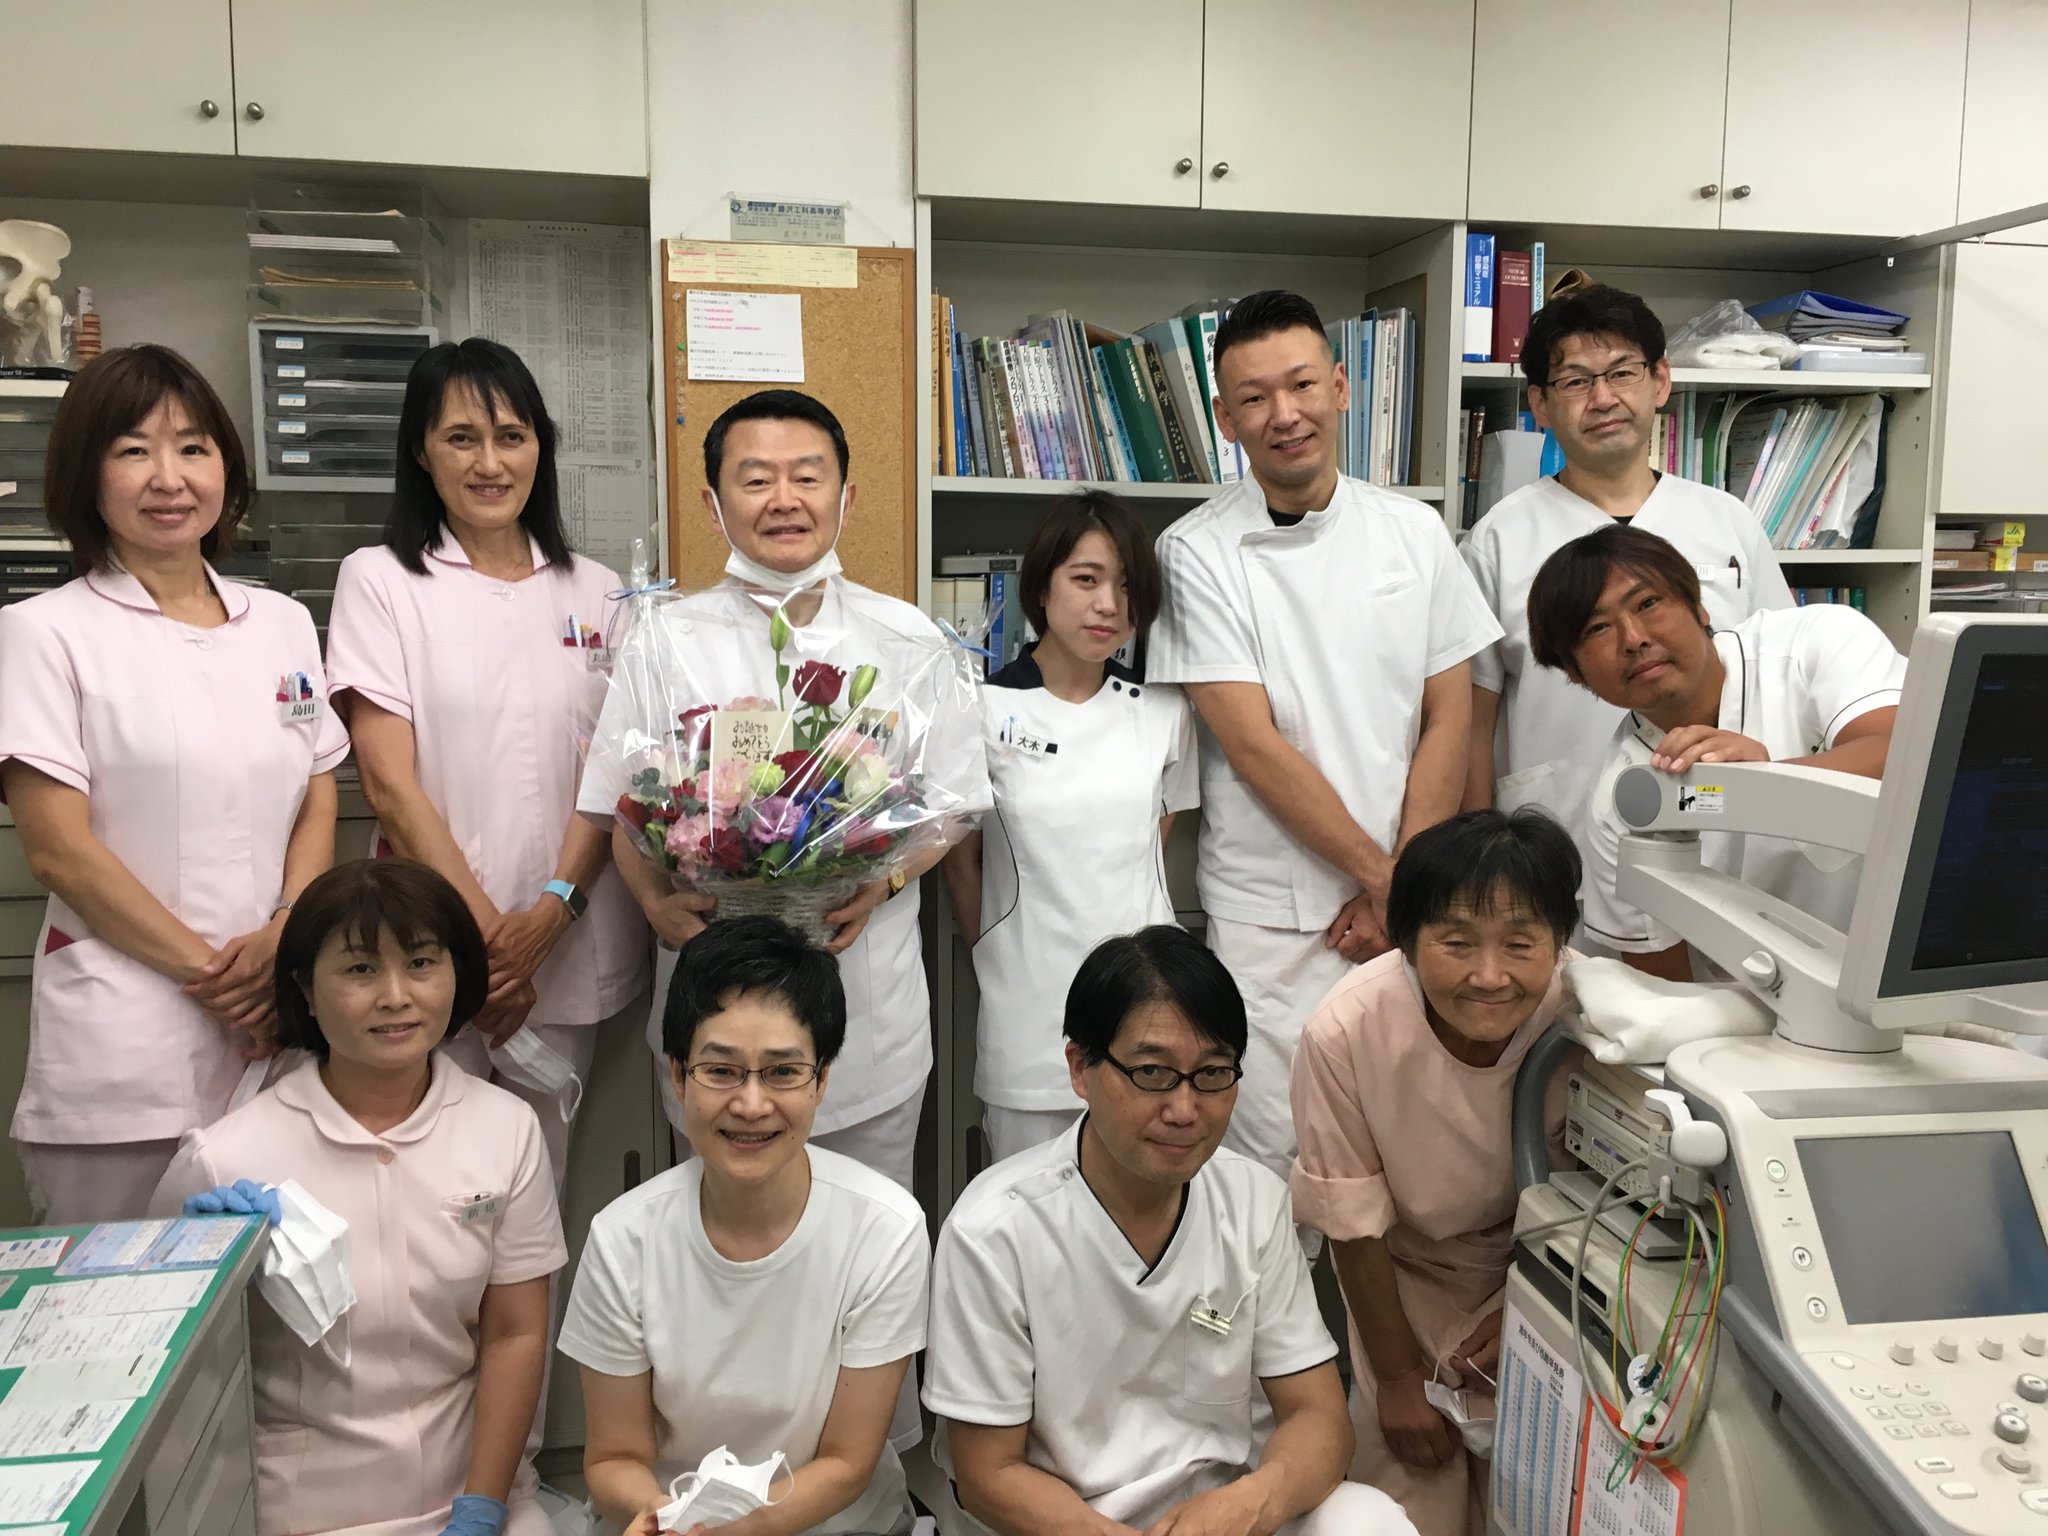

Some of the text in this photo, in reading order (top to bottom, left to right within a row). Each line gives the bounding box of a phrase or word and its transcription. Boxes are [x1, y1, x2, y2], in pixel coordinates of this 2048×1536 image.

[732, 735, 770, 750] おめでとう
